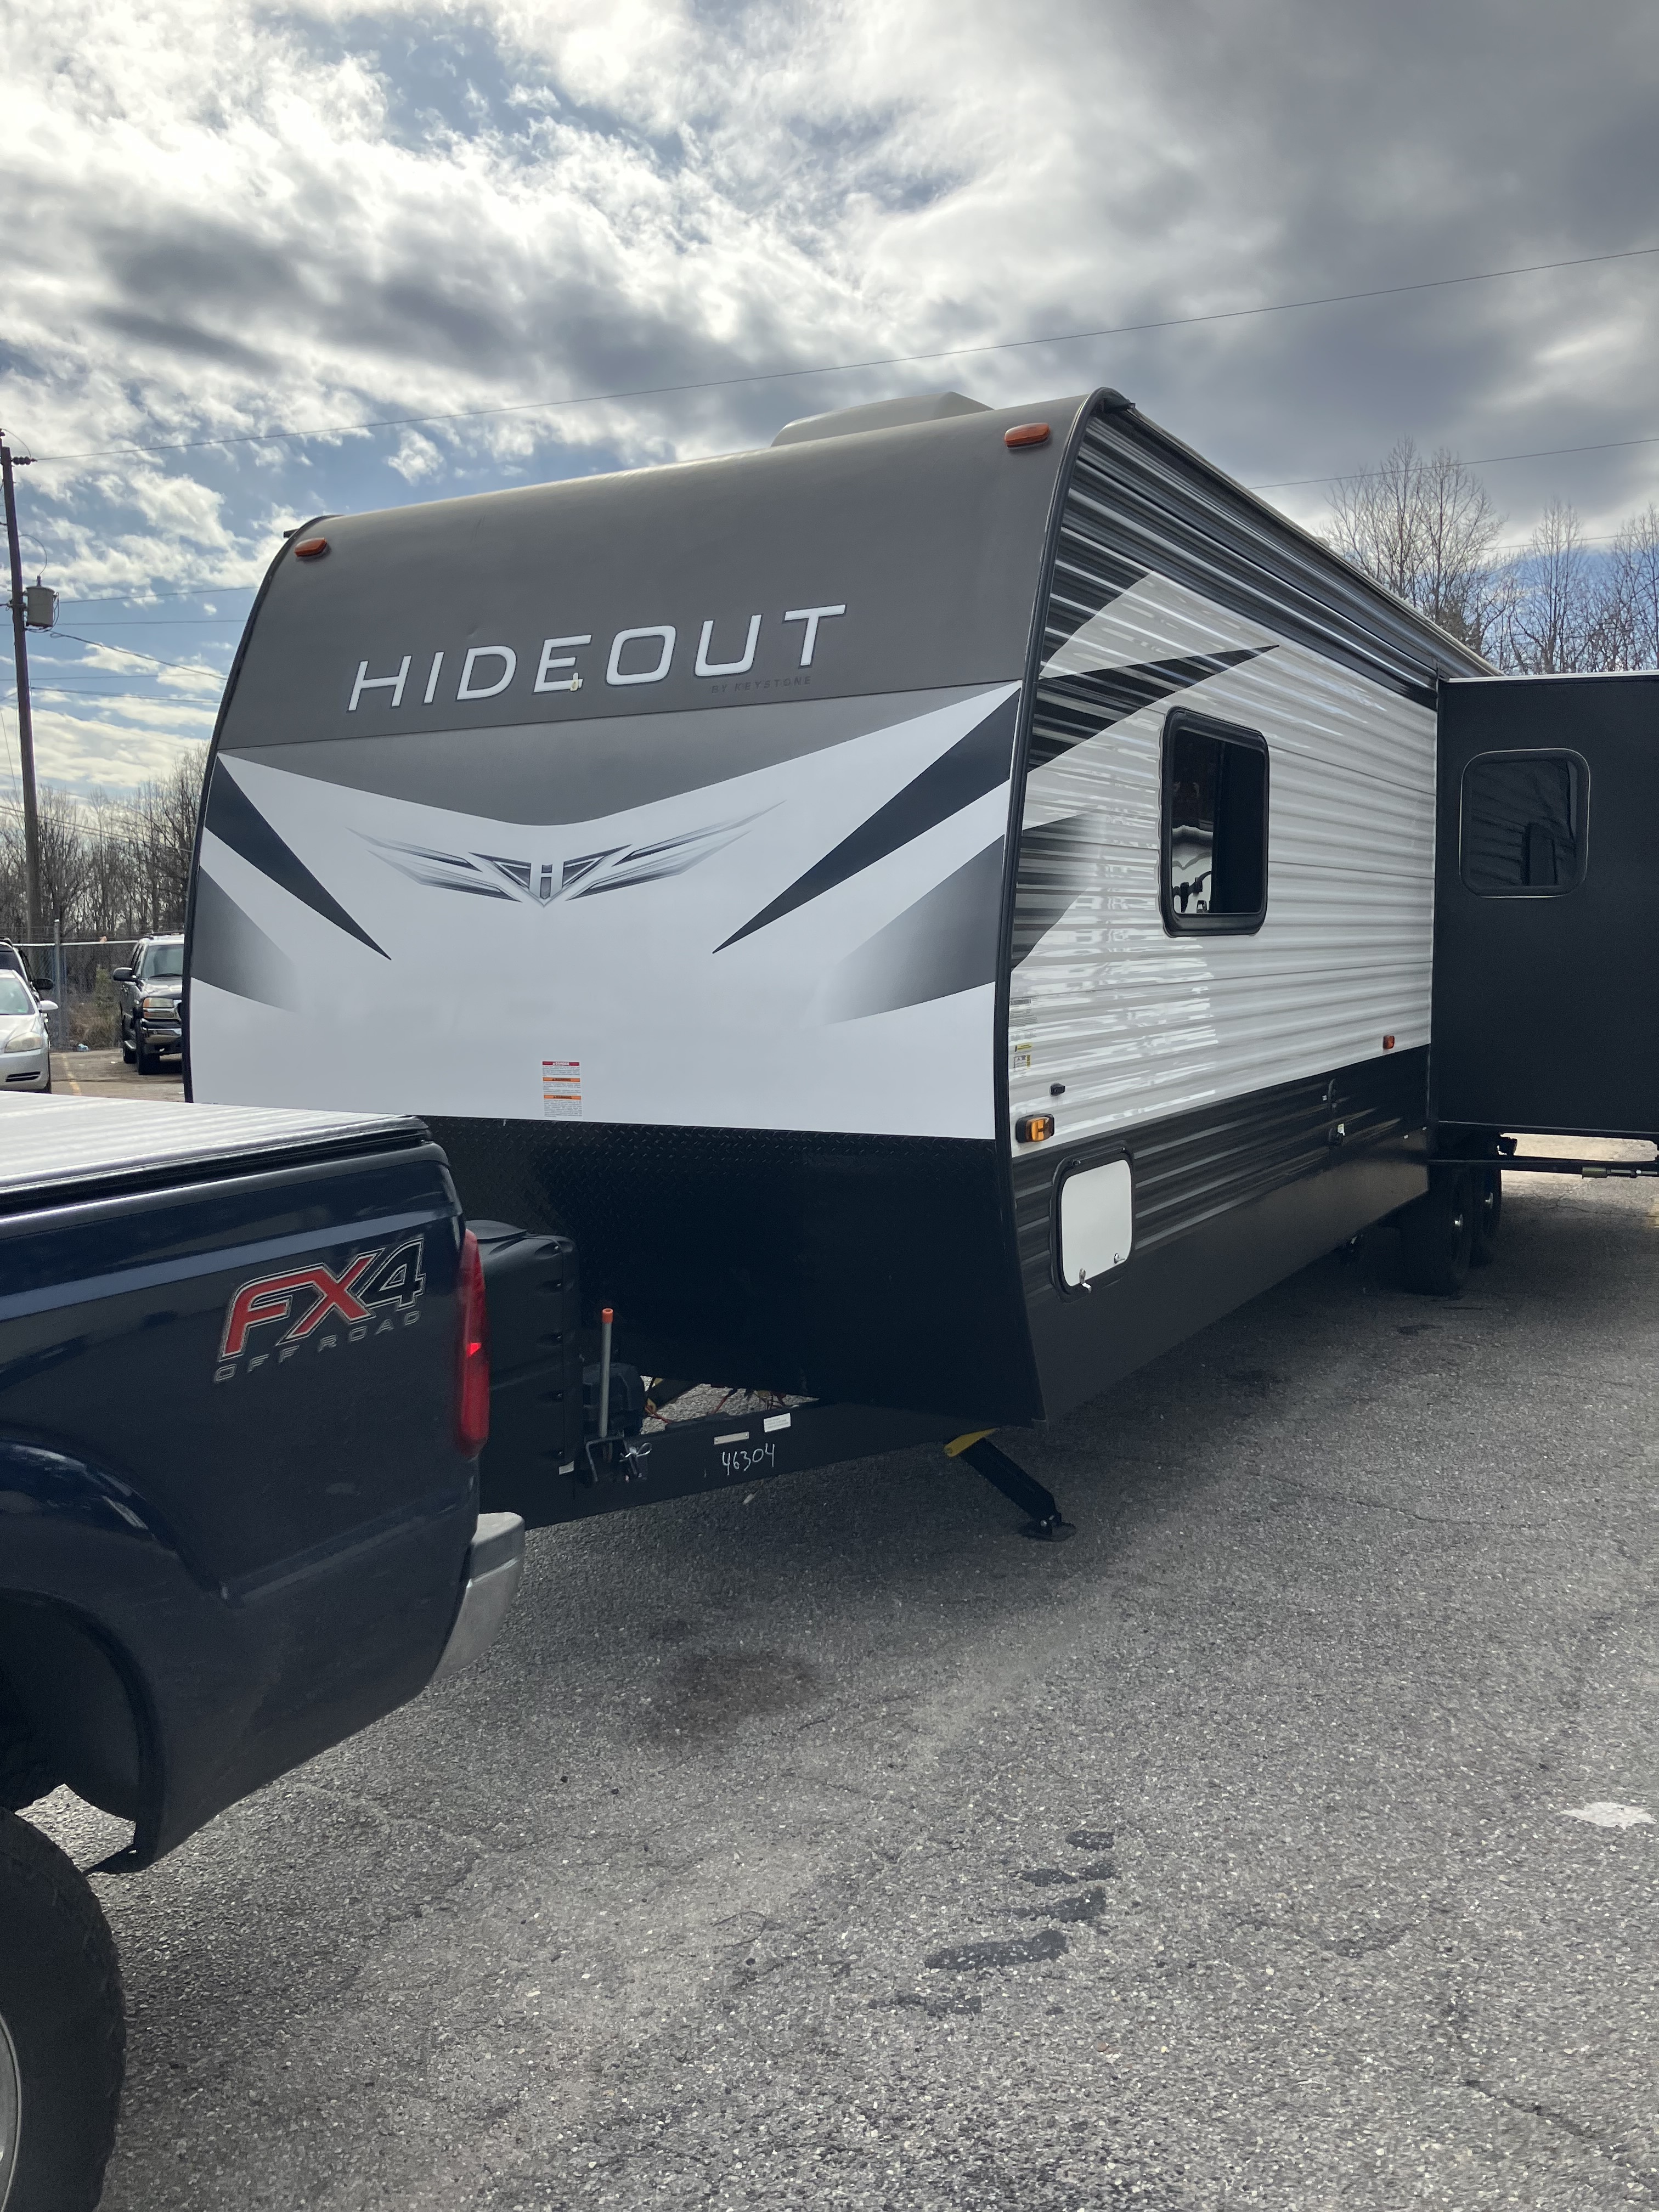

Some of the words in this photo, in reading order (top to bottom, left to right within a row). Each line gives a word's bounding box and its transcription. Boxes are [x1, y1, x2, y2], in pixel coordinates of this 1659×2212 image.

[347, 604, 847, 712] HIDEOUT
[712, 685, 727, 694] BY
[735, 676, 811, 692] KEYSTONE
[219, 1237, 426, 1362] FX4
[215, 1345, 300, 1383] OFF
[318, 1311, 421, 1351] ROAD
[721, 1442, 775, 1476] 46304
